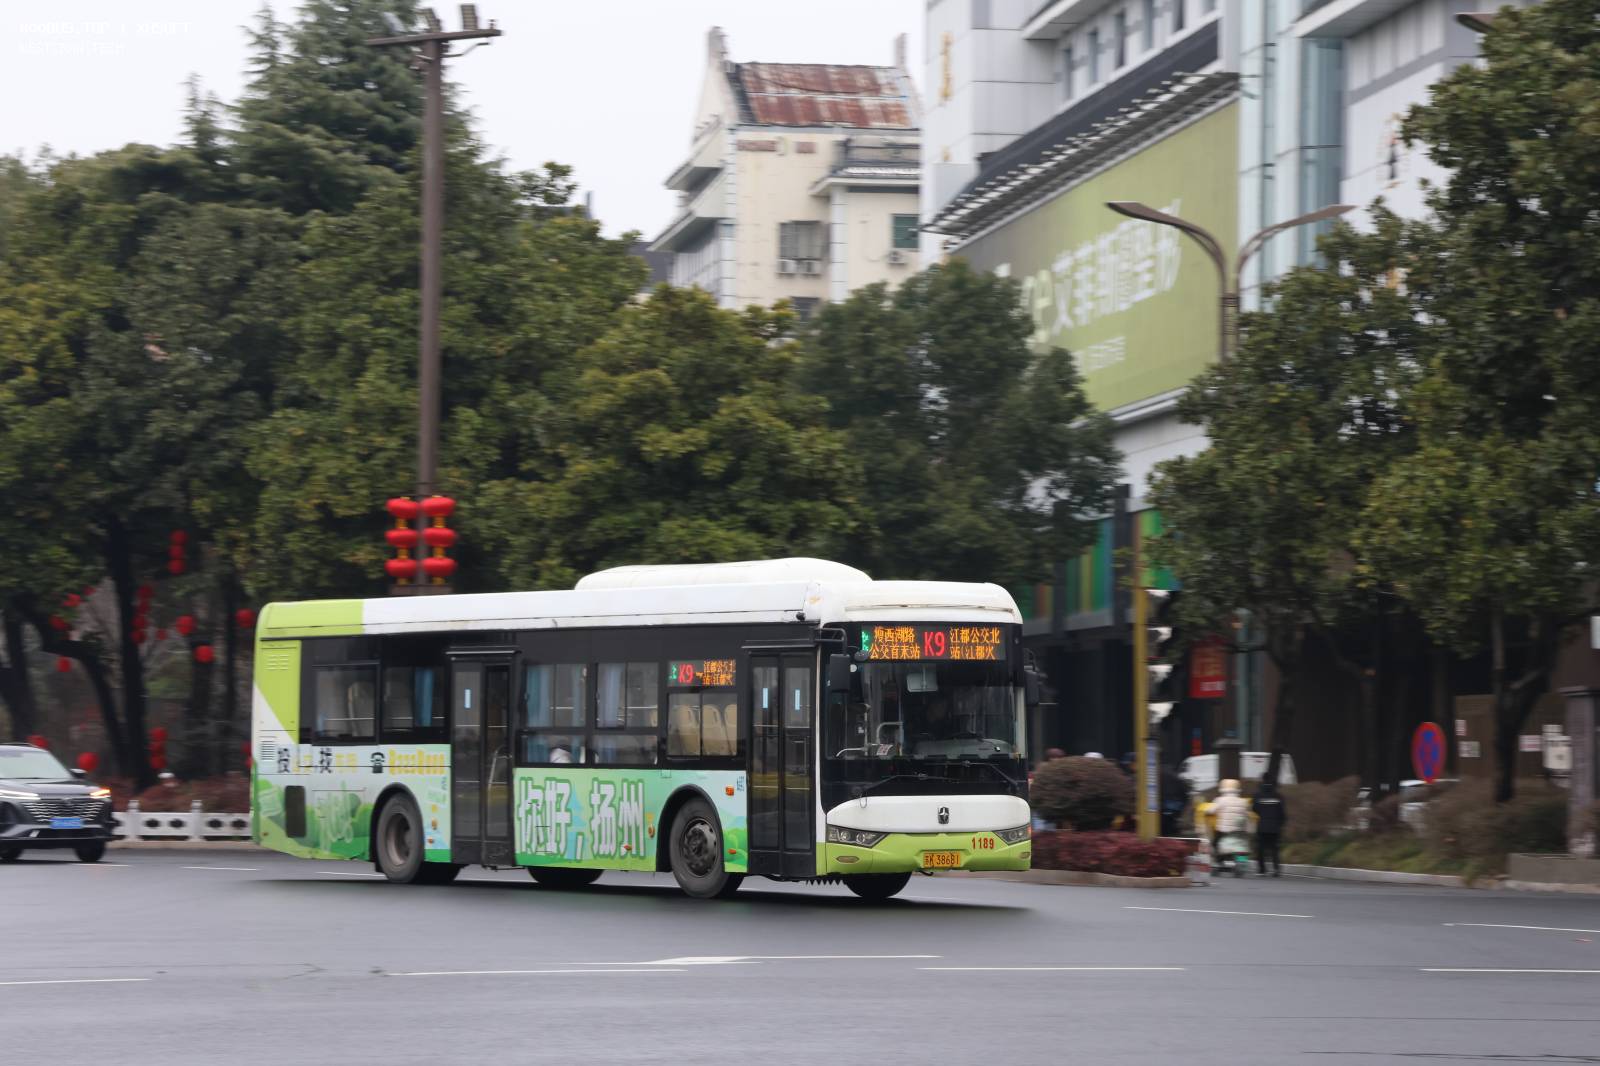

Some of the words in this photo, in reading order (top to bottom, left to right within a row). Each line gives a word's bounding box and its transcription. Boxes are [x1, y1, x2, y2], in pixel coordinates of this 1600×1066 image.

[924, 631, 946, 657] K9
[950, 627, 1001, 645] 江都公交北
[870, 644, 921, 660] 公交首末站
[678, 664, 694, 684] K9
[972, 837, 994, 849] 1189
